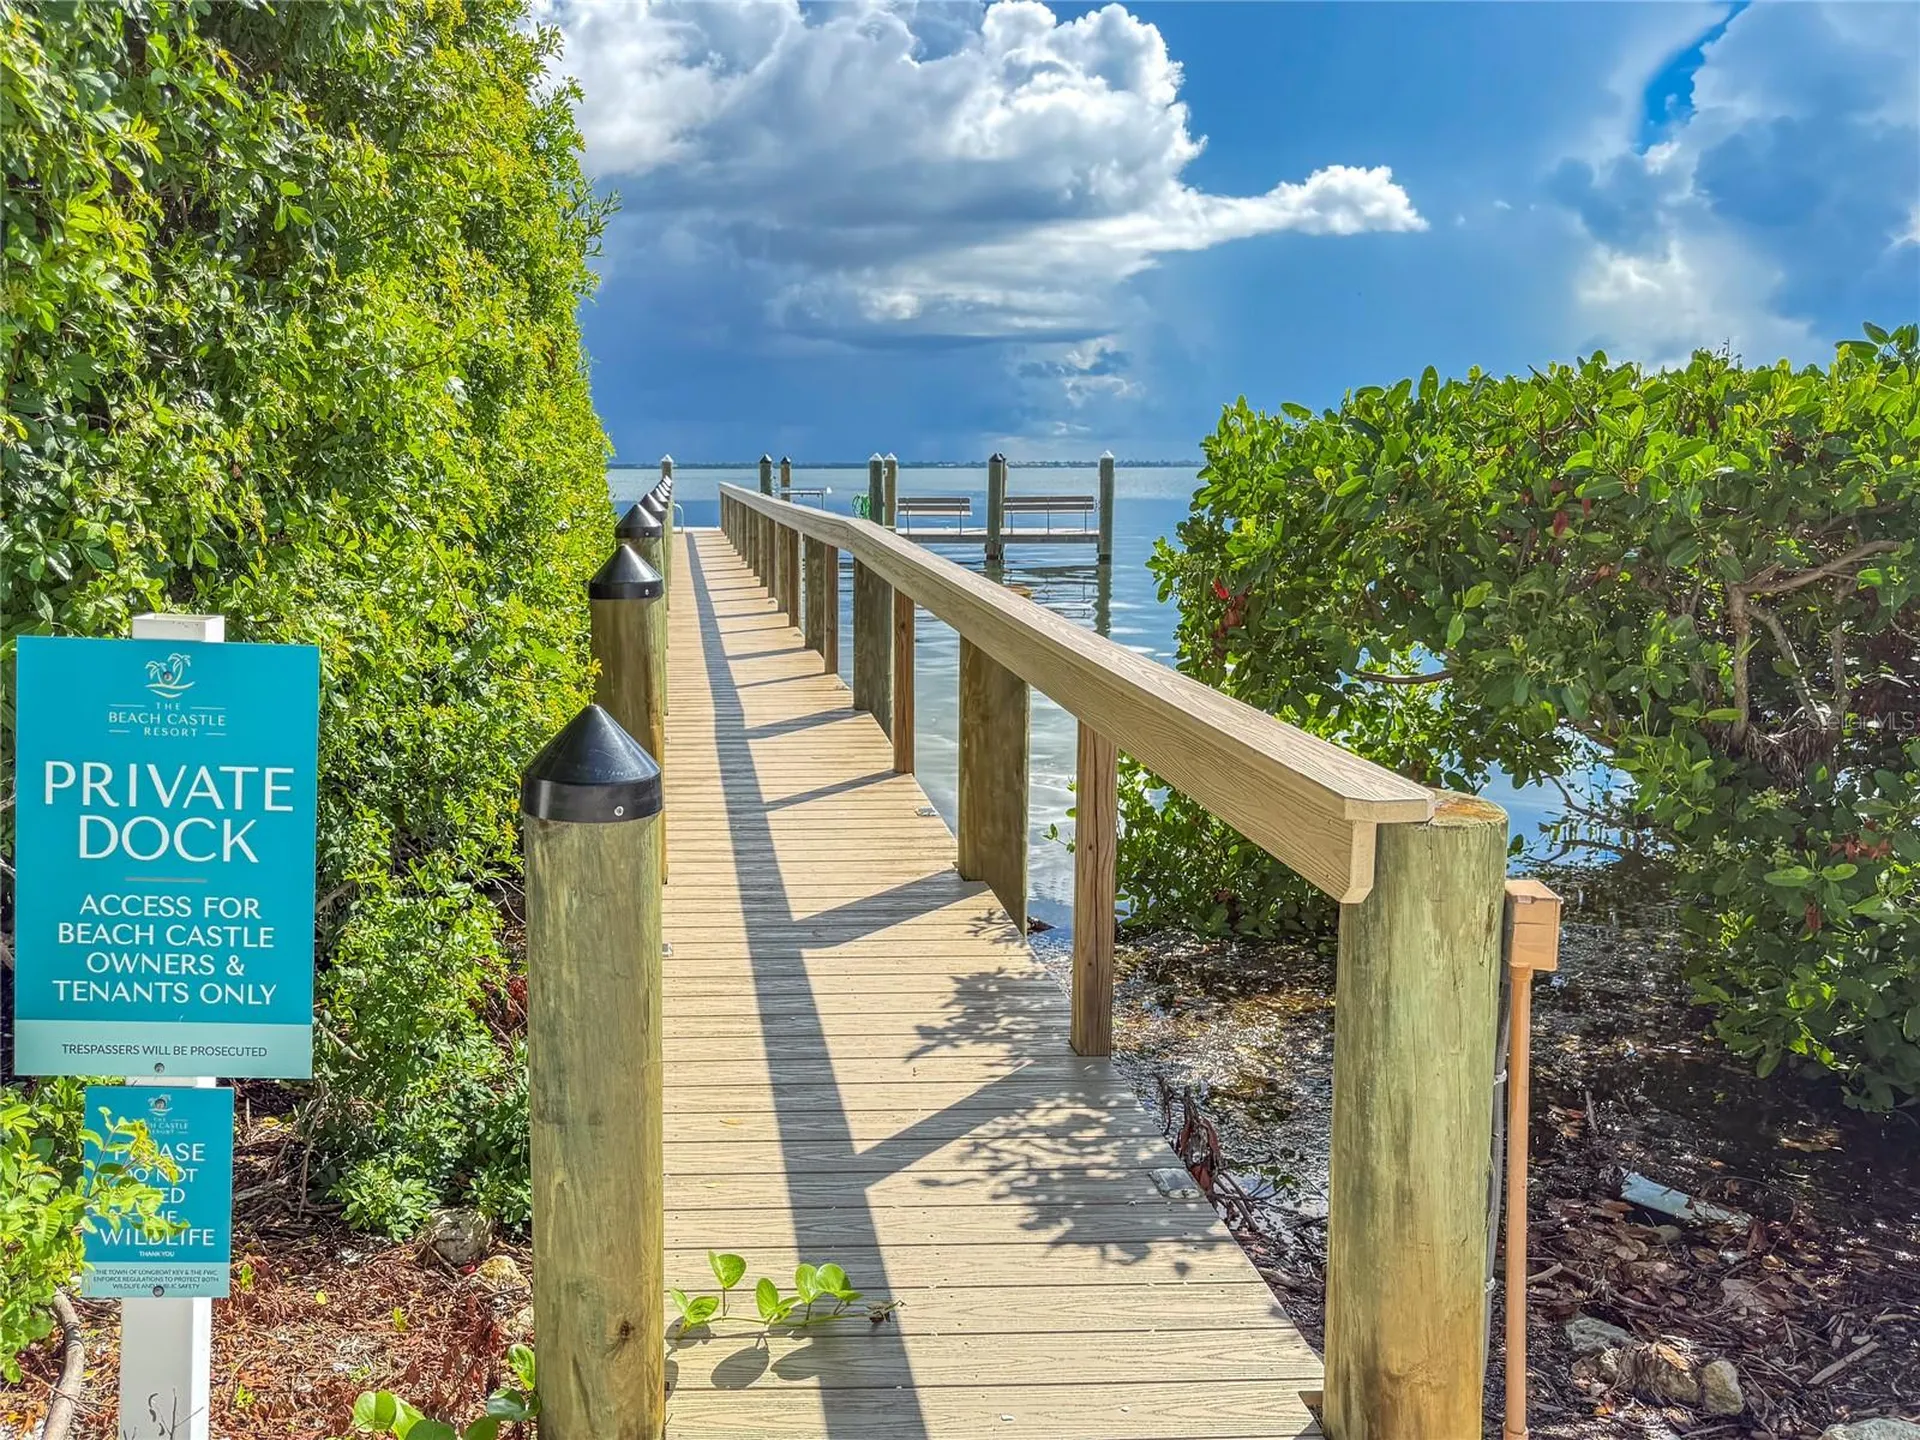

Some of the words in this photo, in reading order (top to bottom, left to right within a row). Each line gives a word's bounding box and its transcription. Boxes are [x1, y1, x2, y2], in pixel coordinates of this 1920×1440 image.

[156, 702, 181, 710] THE
[109, 712, 161, 724] BEACH
[167, 713, 226, 727] CASTLE
[144, 726, 198, 737] RESORT
[44, 760, 295, 812] PRIVATE
[79, 814, 260, 863] DOCK
[80, 894, 192, 918] ACCESS
[204, 897, 261, 919] FOR
[58, 923, 155, 946] BEACH
[166, 924, 274, 948] CASTLE
[86, 952, 215, 976] OWNERS
[226, 955, 245, 976] &
[52, 980, 189, 1004] TENANTS
[200, 983, 277, 1006] ONLY
[62, 1043, 140, 1055] TRESPASSERS
[141, 1045, 171, 1056] WILL
[173, 1045, 188, 1056] BE
[190, 1046, 267, 1057] PROSECUTED
[114, 1143, 206, 1161] PASE
